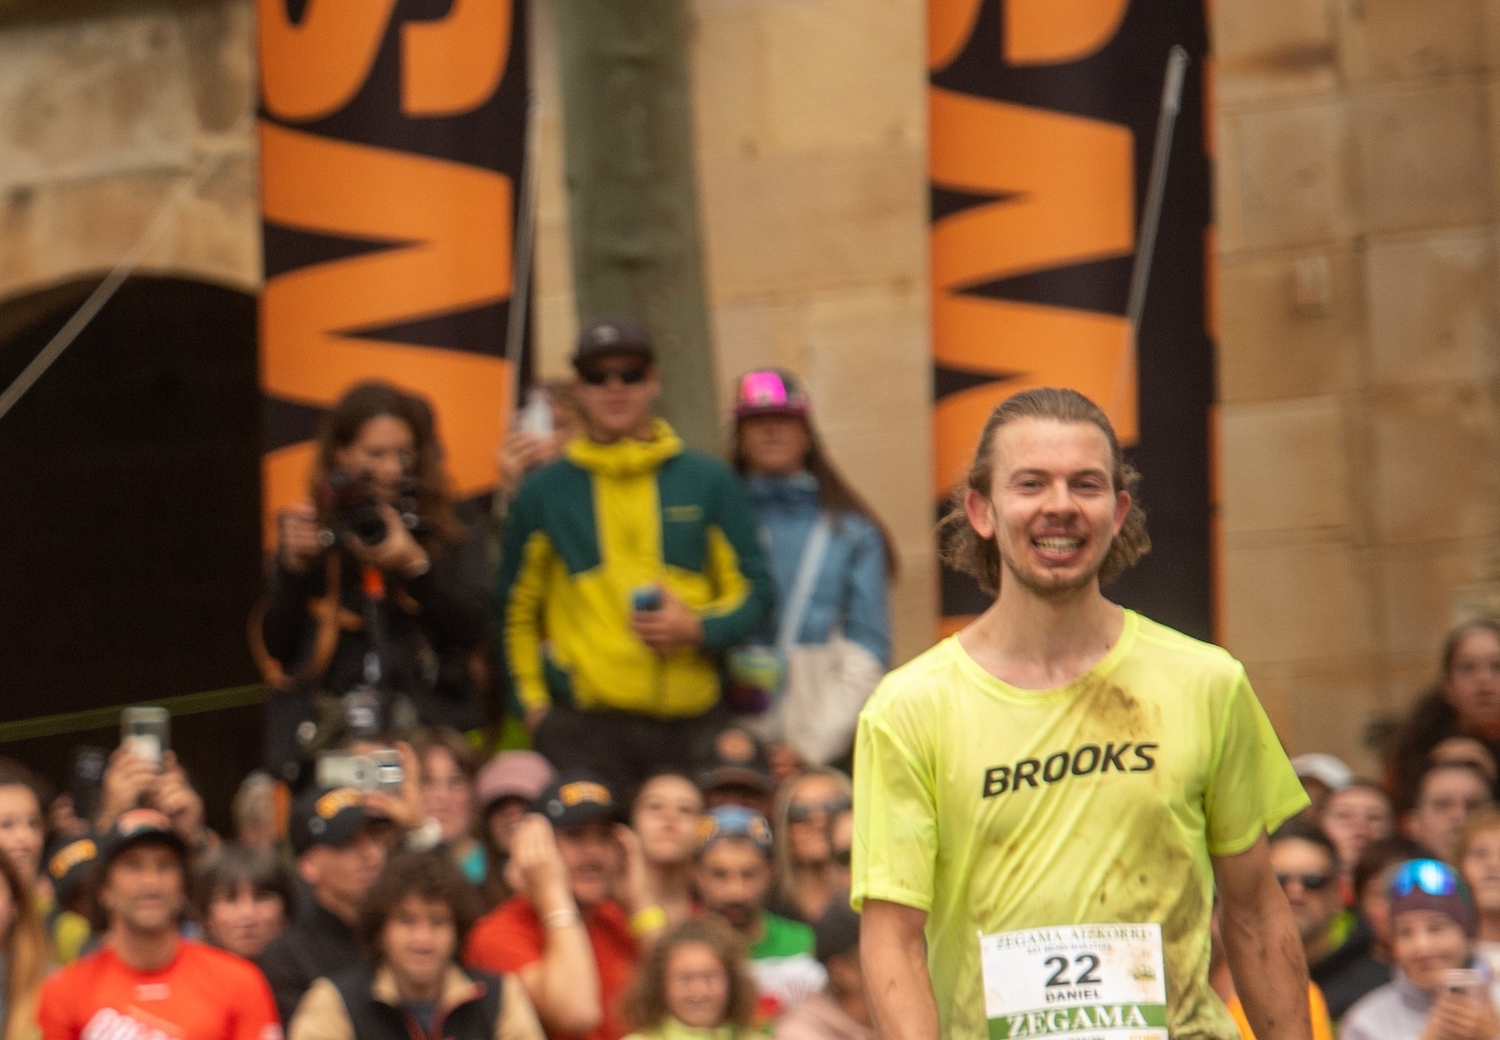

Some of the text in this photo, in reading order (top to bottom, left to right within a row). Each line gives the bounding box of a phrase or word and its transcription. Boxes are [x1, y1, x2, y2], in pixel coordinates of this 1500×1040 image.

[982, 742, 1158, 799] BROOKS
[1044, 954, 1102, 987] 22
[1046, 990, 1102, 1003] DANIEL
[1006, 1004, 1148, 1039] ZEGAMA
